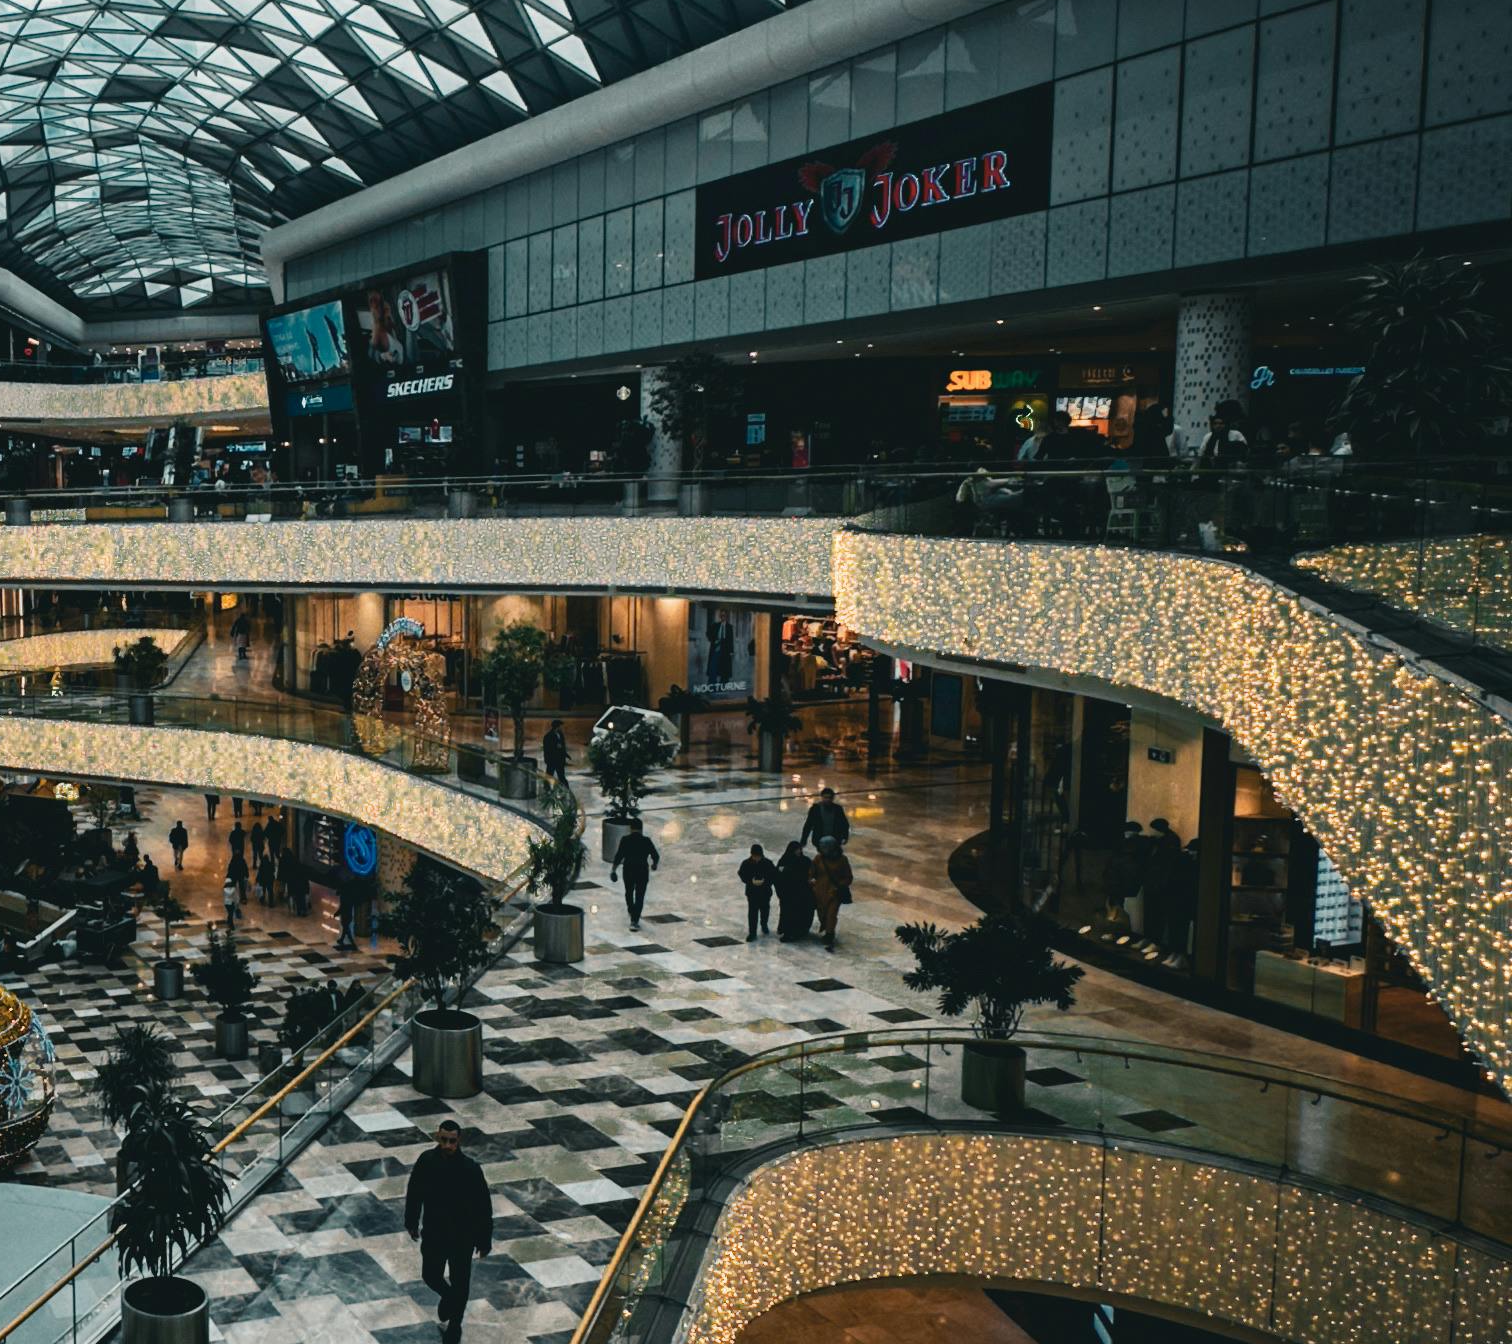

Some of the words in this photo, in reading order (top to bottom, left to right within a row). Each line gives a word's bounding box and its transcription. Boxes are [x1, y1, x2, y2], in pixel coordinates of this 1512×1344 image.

[714, 199, 814, 263] JOLLY
[870, 150, 1011, 229] JOKER
[386, 374, 455, 398] SKECHERS
[945, 370, 1042, 392] SUBWAY
[692, 680, 747, 694] NOCTURNE
